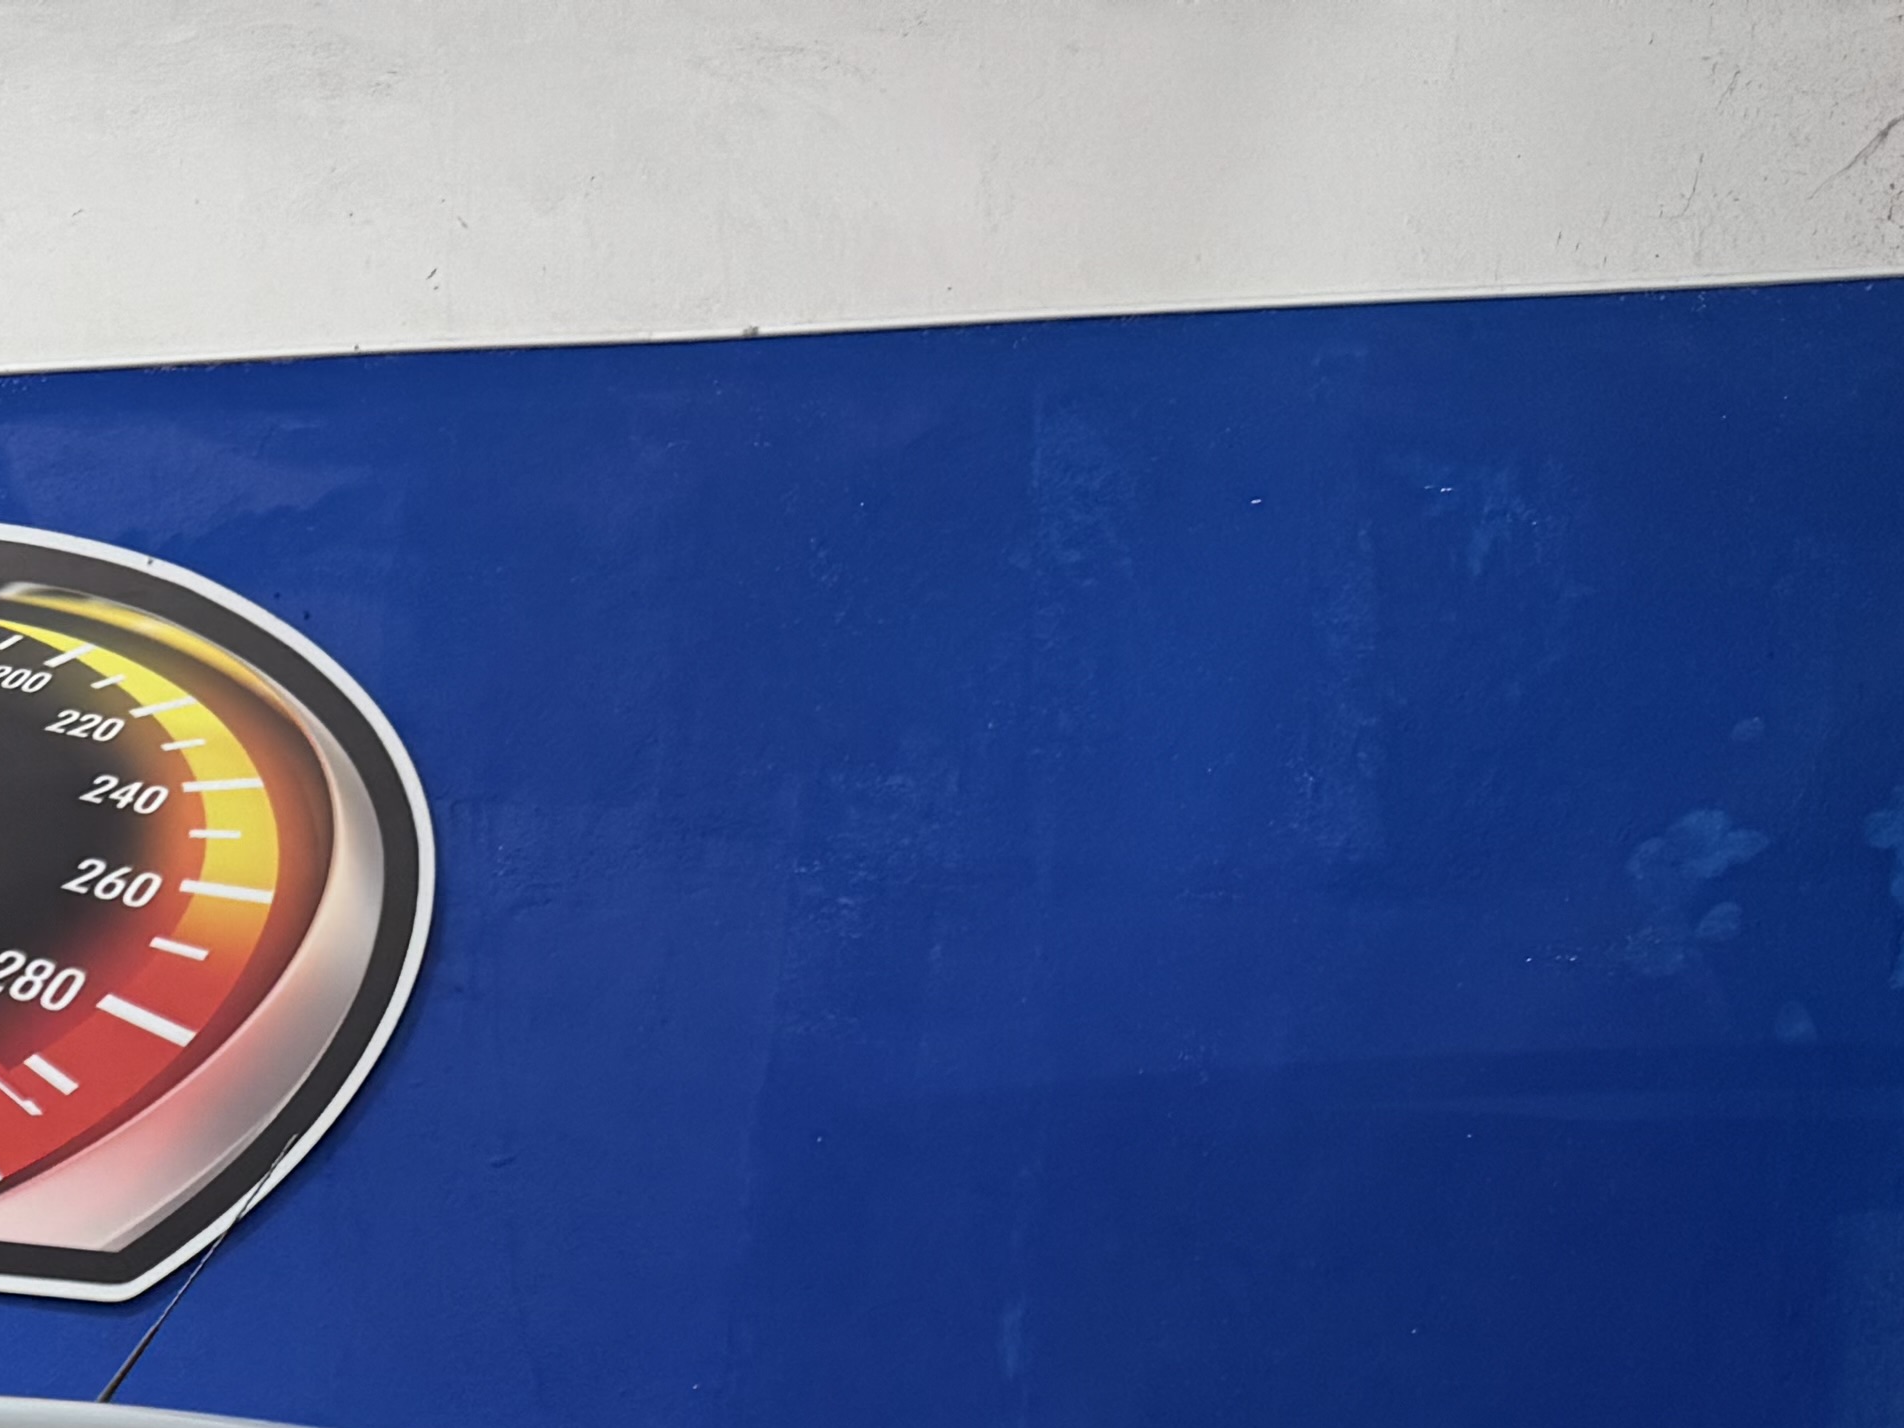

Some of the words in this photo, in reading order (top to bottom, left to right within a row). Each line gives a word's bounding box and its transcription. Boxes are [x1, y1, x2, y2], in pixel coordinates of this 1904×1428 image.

[44, 708, 125, 743] 220
[79, 774, 170, 816] 240
[60, 857, 163, 909] 260
